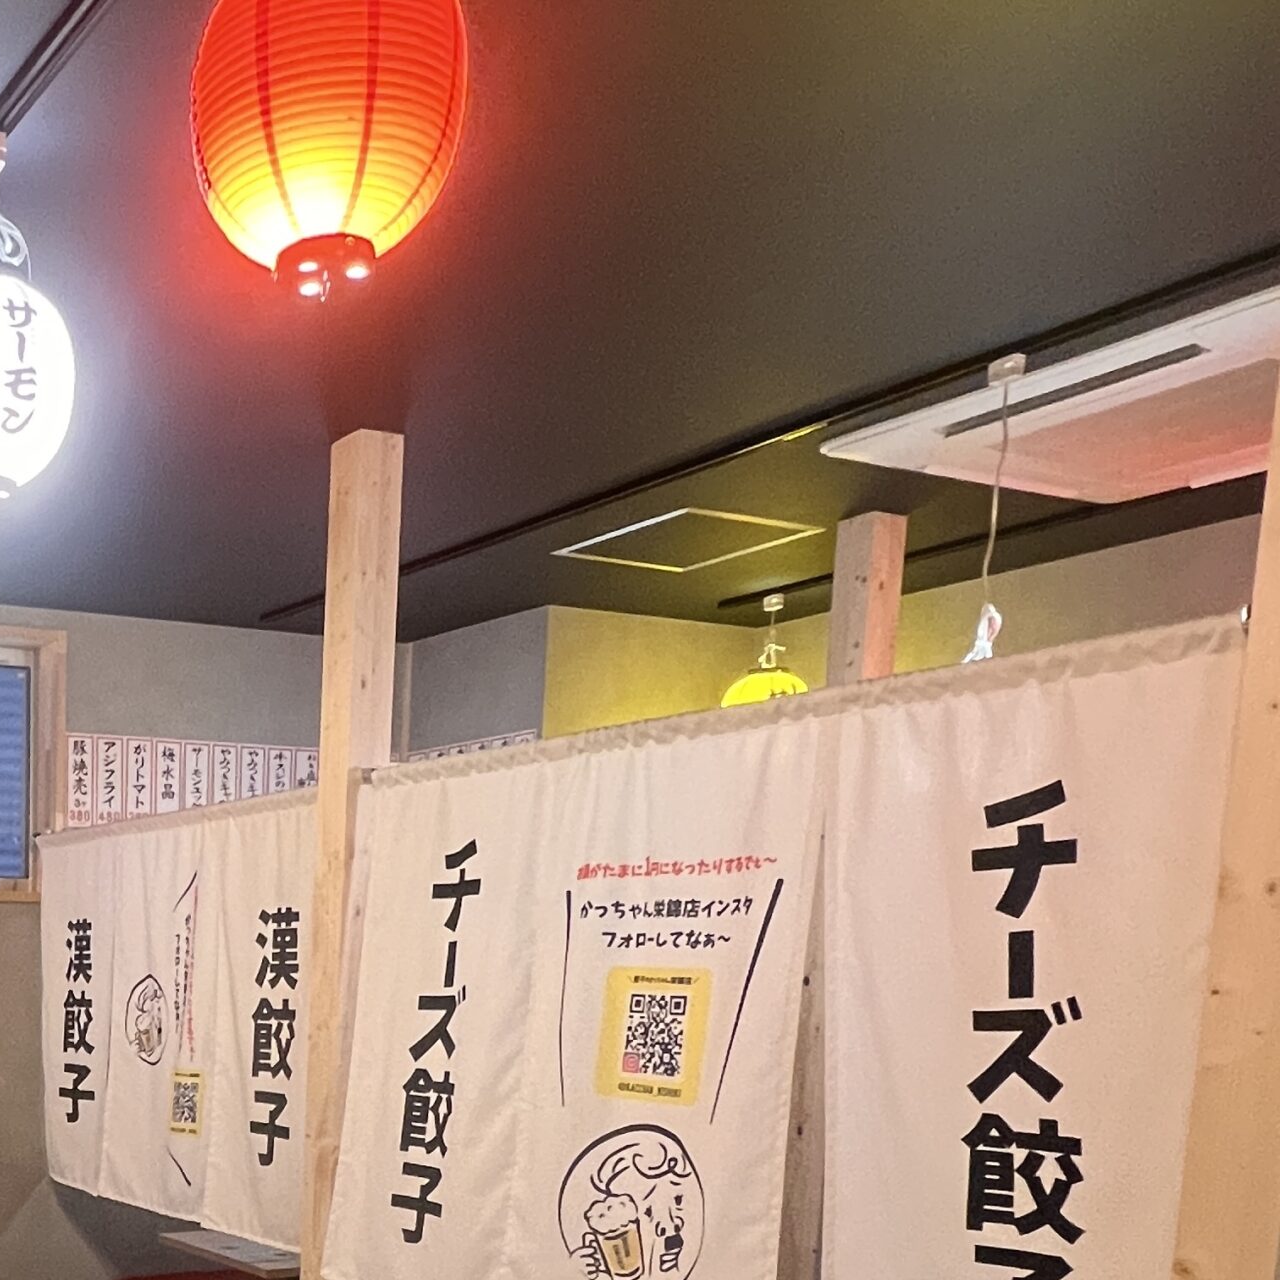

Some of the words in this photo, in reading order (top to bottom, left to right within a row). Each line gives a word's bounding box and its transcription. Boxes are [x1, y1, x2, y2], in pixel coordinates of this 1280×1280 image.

[1, 298, 38, 434] サーモン
[103, 741, 117, 808] アジフライ
[133, 744, 146, 808] がりトマト
[58, 918, 96, 1123] 漢餃子
[249, 907, 300, 1166] 漢餃子
[390, 839, 481, 1244] チーズ餃子
